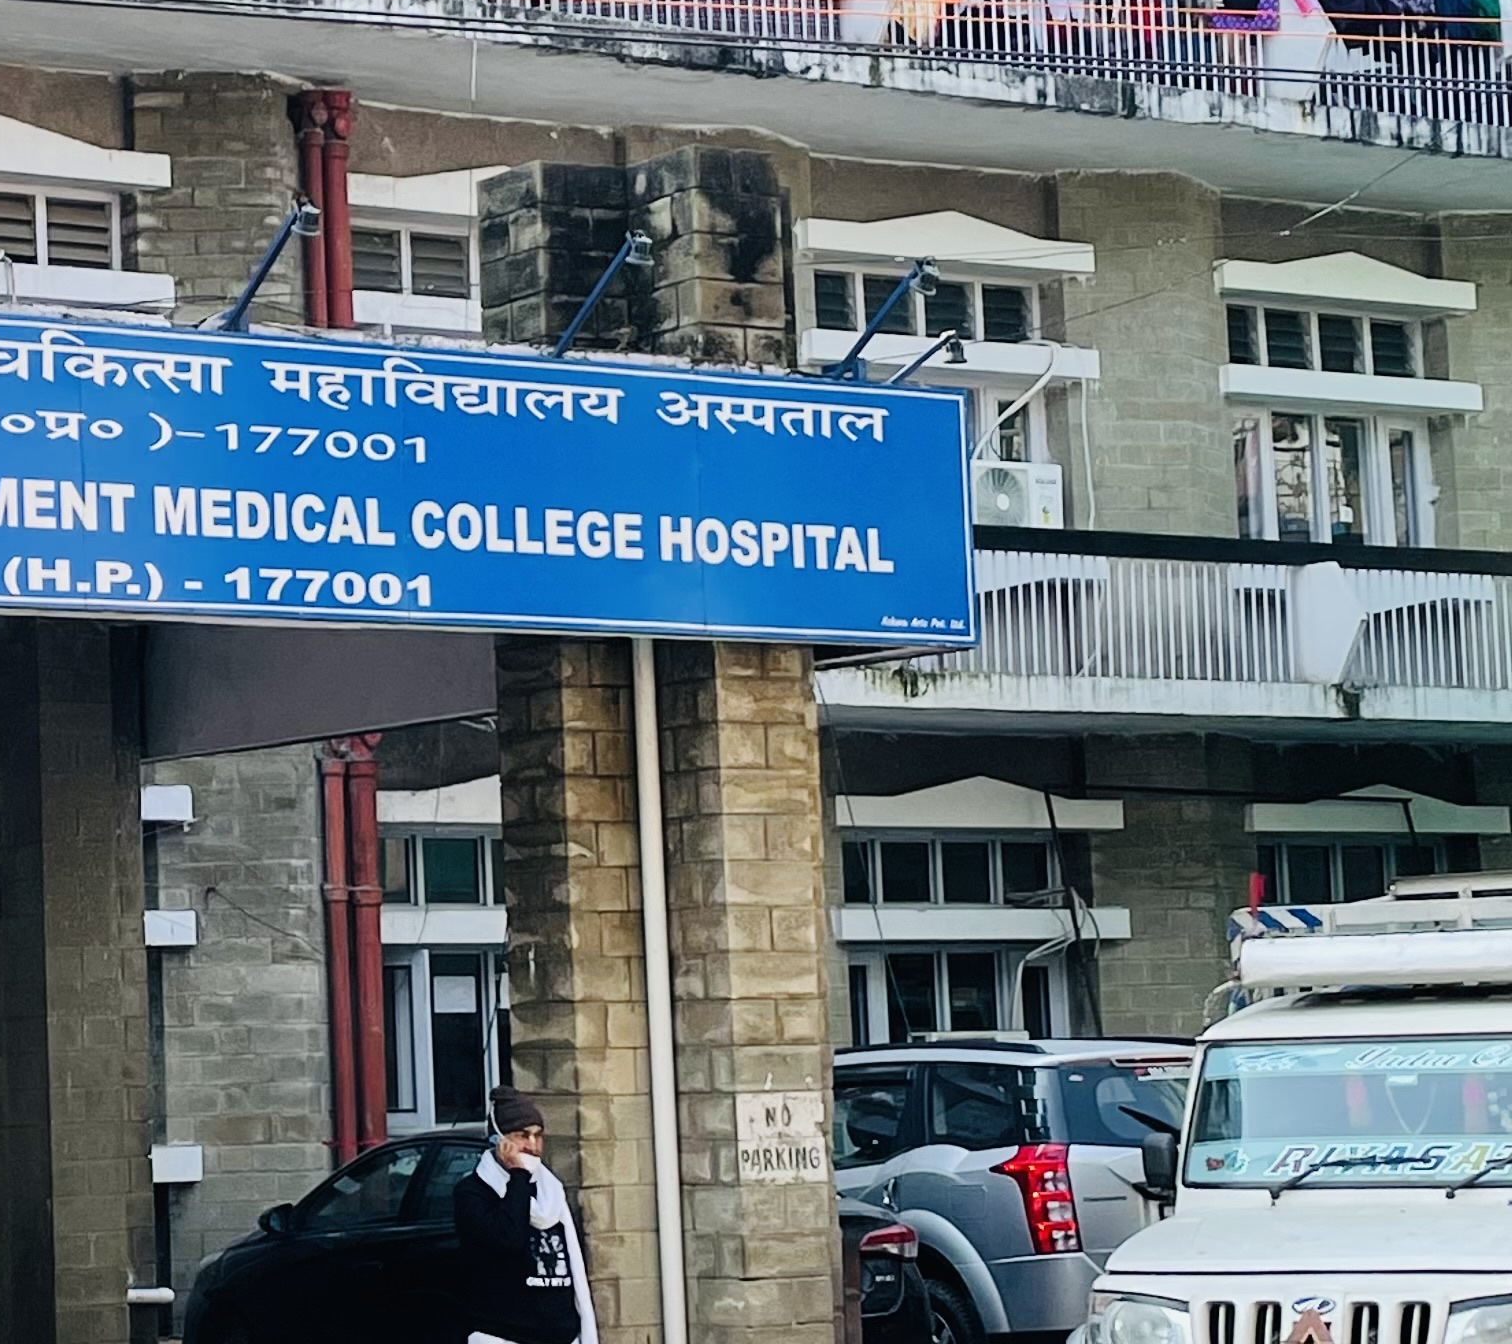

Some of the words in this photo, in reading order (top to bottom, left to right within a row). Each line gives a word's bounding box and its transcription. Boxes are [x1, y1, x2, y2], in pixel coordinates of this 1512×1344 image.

[262, 357, 624, 424] महाविद्यालय
[657, 392, 888, 441] अस्पताल
[154, 486, 395, 545] MEDICAL
[412, 501, 643, 559] COLLEGE
[661, 516, 893, 572] HOSPITAL
[4, 557, 163, 601] (H.P.)
[225, 568, 430, 606] 177001
[765, 1103, 791, 1127] NO
[741, 1146, 820, 1172] PARKING
